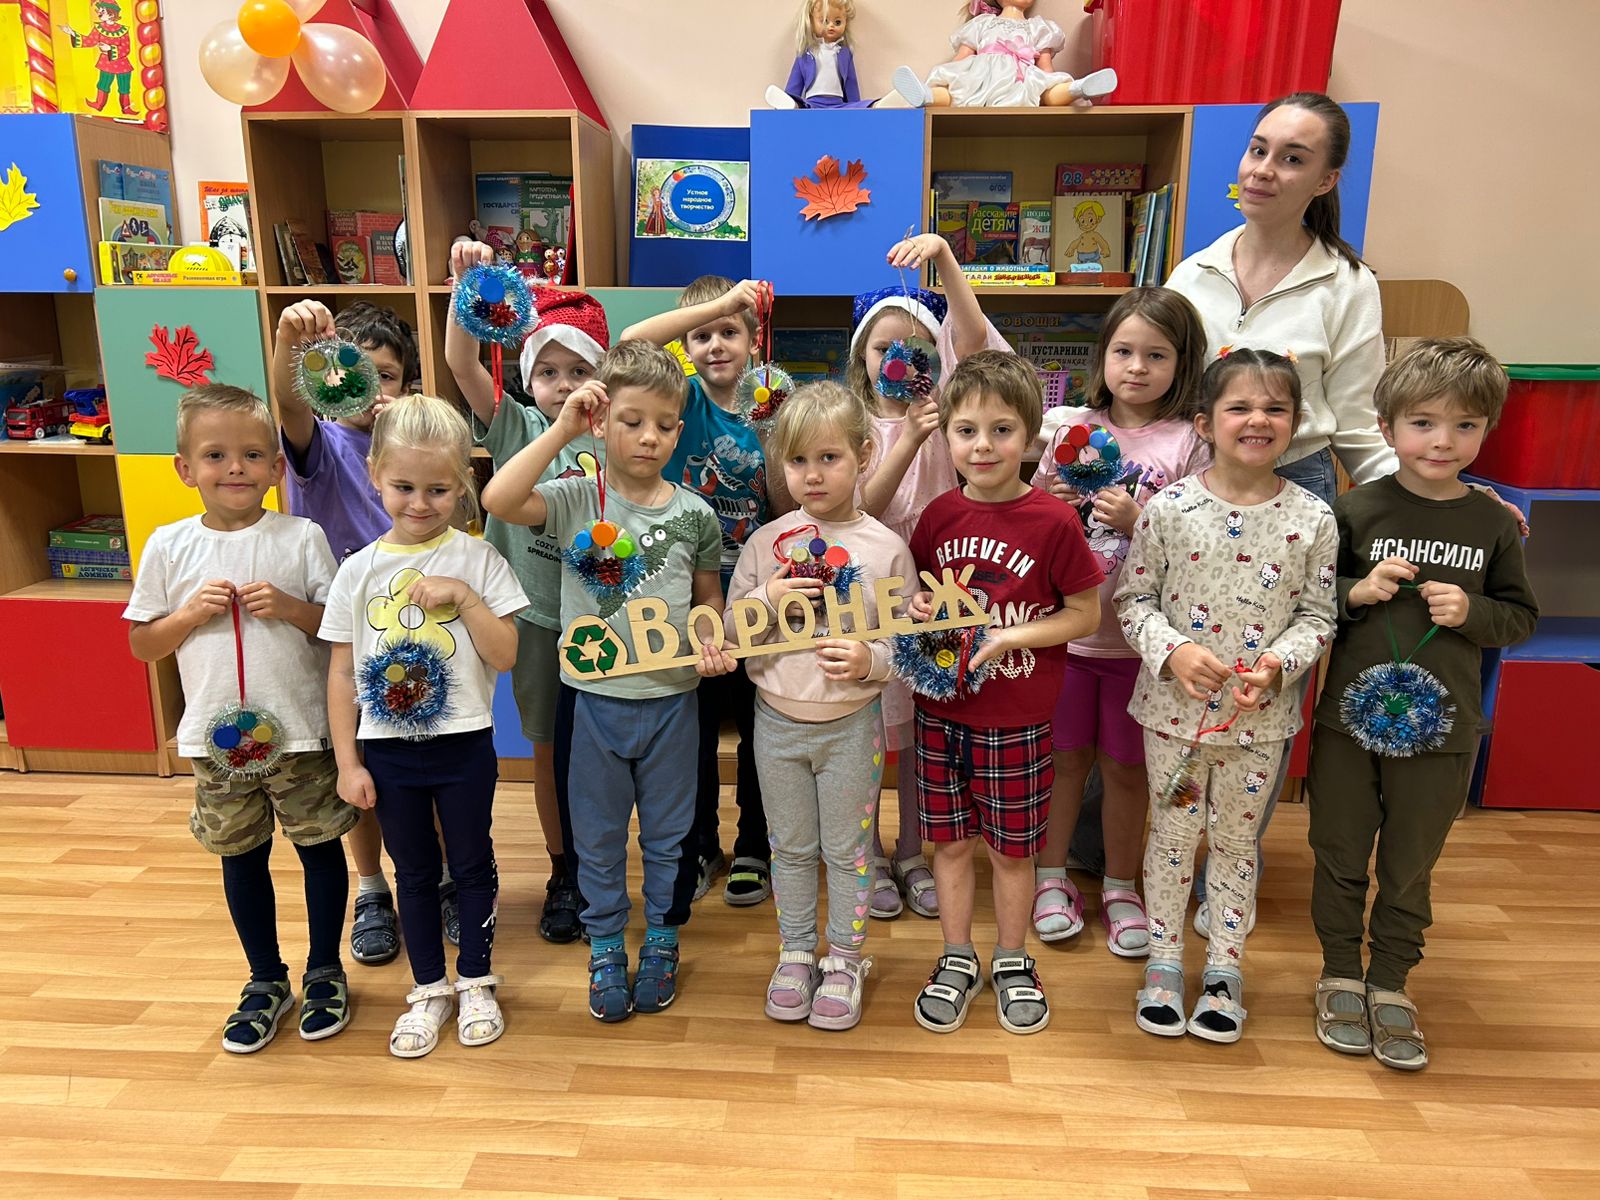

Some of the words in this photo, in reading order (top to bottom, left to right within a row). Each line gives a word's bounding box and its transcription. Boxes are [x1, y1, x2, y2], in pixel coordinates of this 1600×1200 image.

[1062, 171, 1083, 185] 28
[682, 196, 712, 204] народное
[680, 203, 715, 211] творчество
[973, 207, 1017, 219] Расскажите
[1032, 225, 1051, 233] ЖИ
[1001, 316, 1061, 328] ОВОЩИ
[1031, 345, 1089, 356] КУСТАРНИКИ
[535, 539, 555, 551] COZY
[935, 536, 1008, 568] BELIEVE
[1006, 548, 1036, 579] IN
[1369, 538, 1485, 572] #СЫНСИЛА
[1235, 594, 1253, 605] Hello
[1252, 600, 1267, 613] Kitty
[626, 563, 988, 664] ВОРОНЕЖ
[1239, 744, 1255, 753] ello
